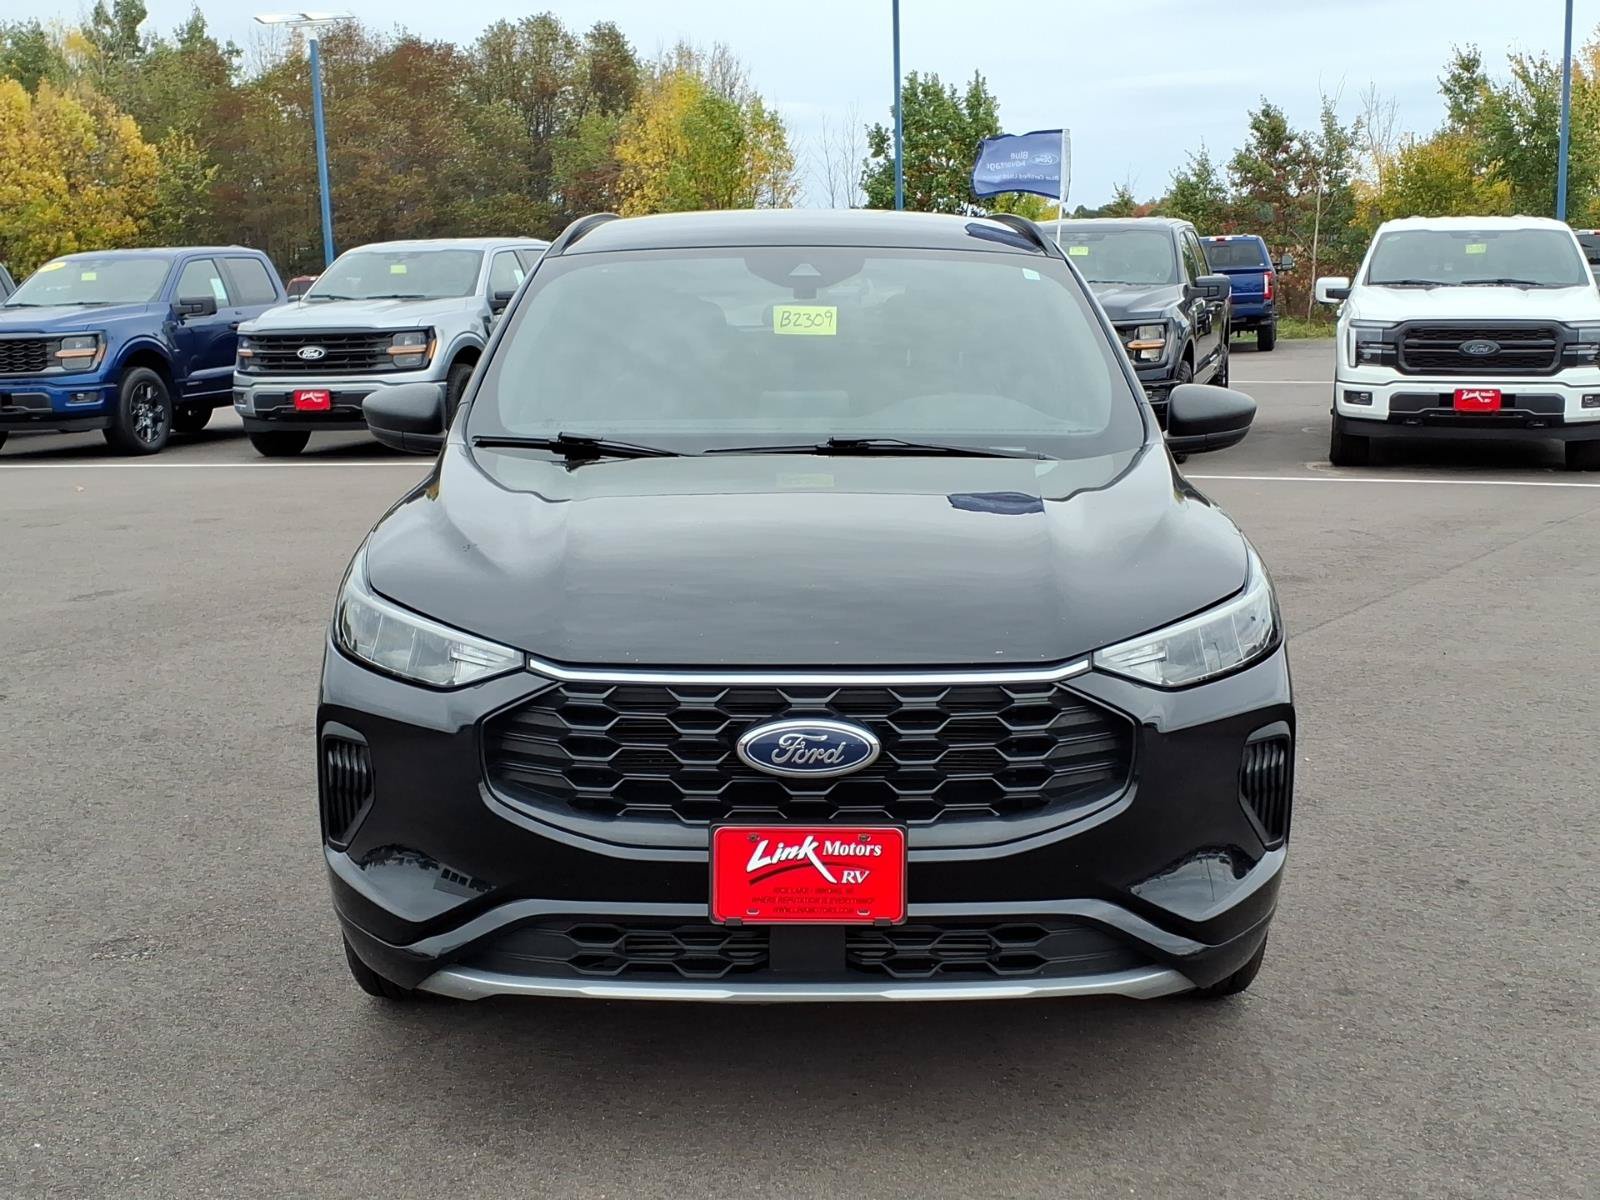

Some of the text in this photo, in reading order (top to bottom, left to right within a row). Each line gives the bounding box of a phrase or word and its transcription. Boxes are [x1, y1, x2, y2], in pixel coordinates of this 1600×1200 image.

[780, 310, 833, 328] B2309
[302, 348, 320, 358] Ford
[771, 733, 846, 764] Ford
[746, 835, 882, 884] Link Motors
[841, 870, 870, 884] RV
